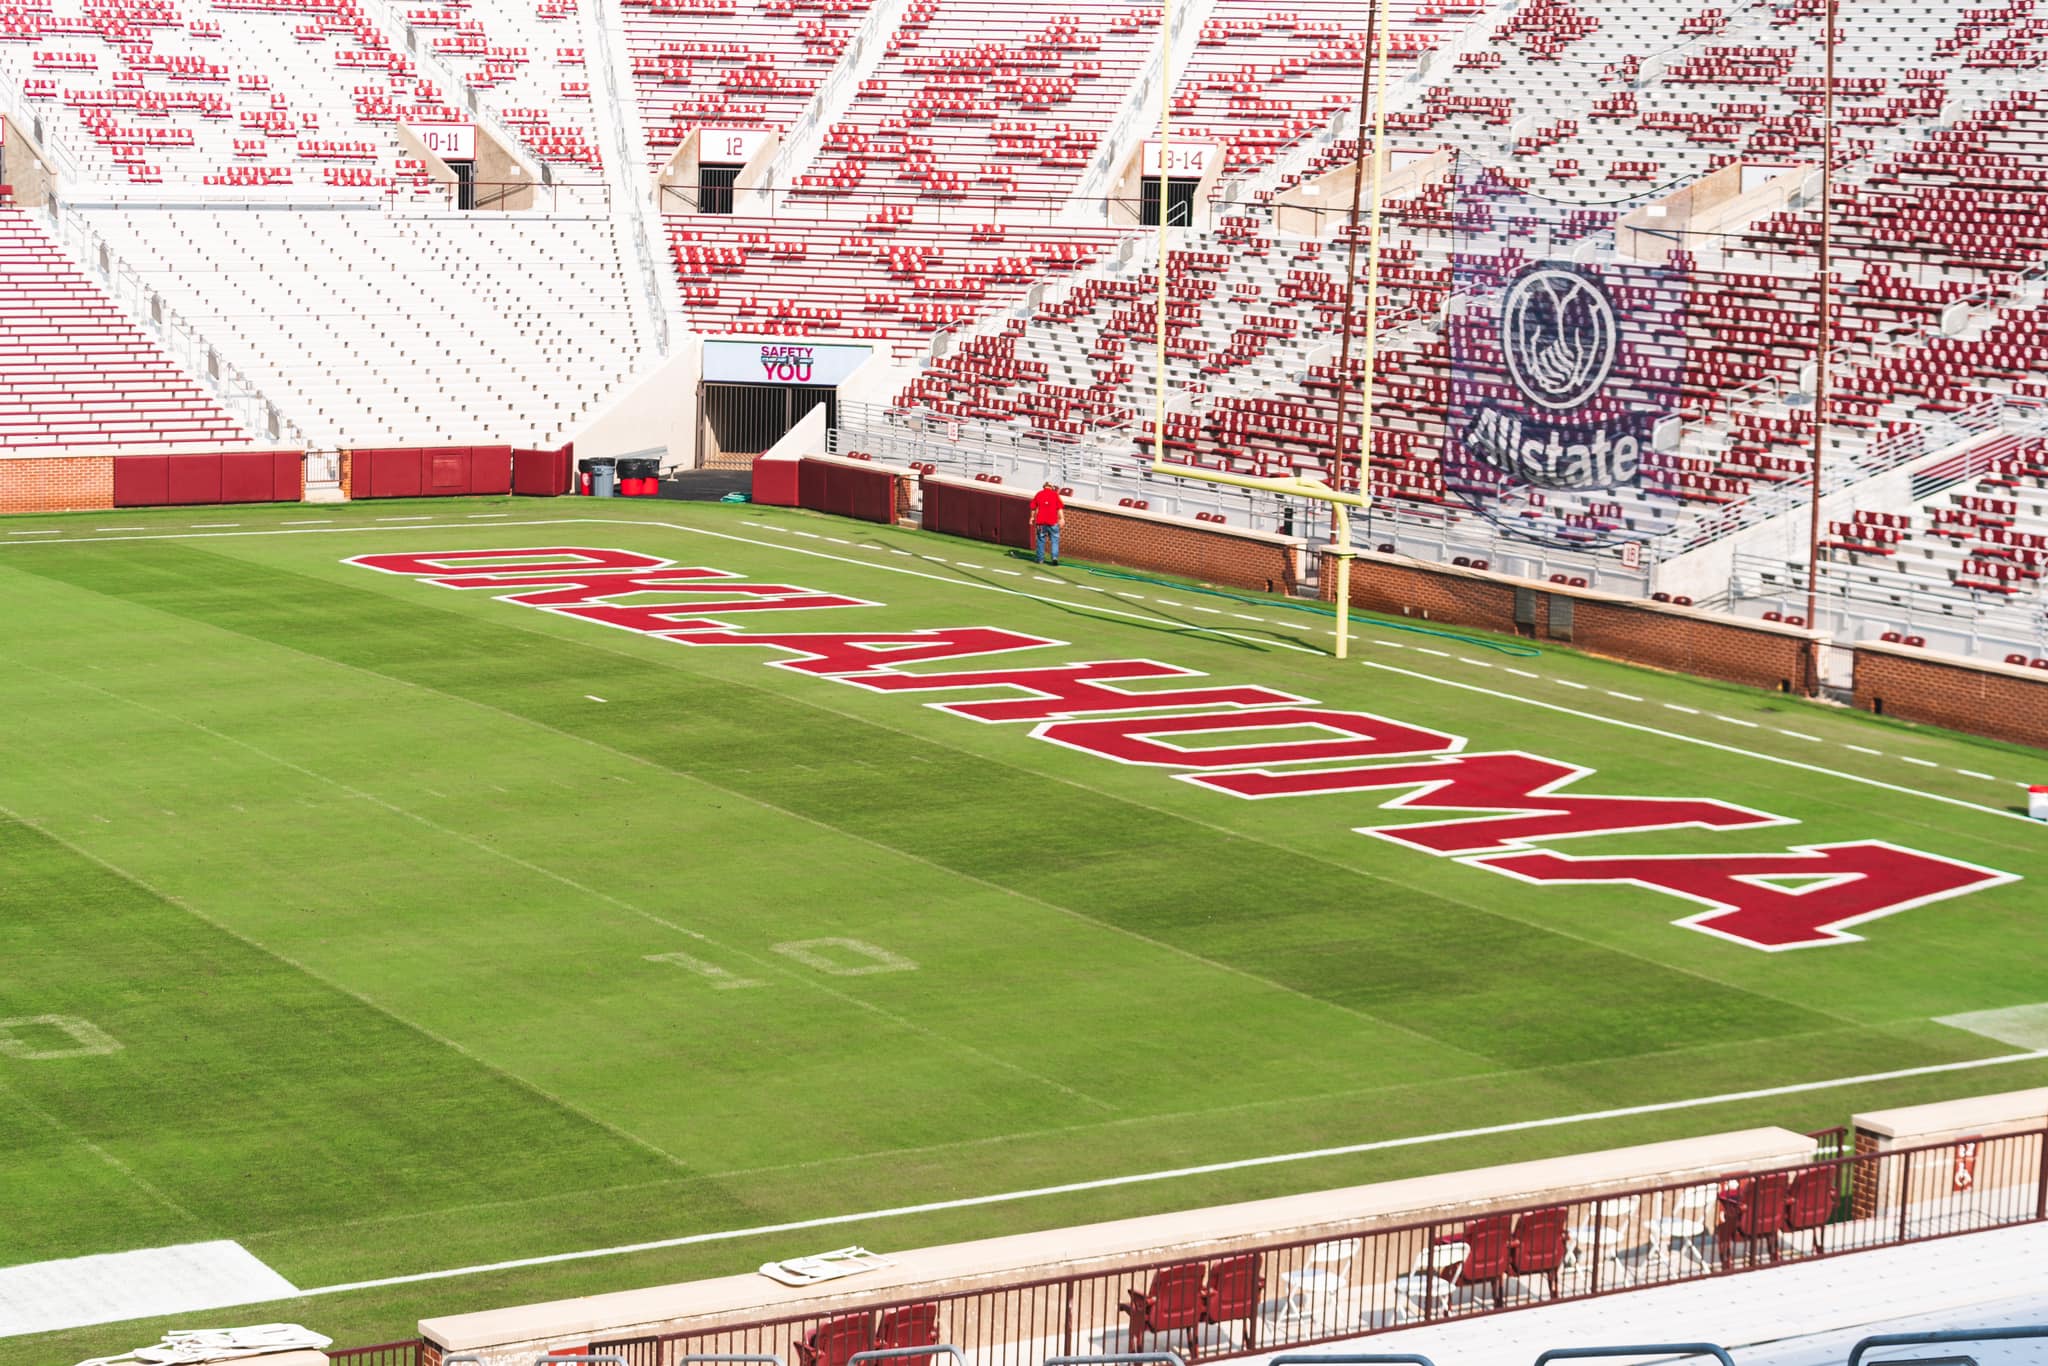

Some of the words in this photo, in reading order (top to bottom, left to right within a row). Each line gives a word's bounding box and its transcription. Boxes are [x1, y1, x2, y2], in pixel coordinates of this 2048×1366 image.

[422, 132, 459, 152] 10-11
[726, 137, 743, 156] 12
[1157, 150, 1203, 170] 13-14
[761, 346, 813, 358] SAFETY
[762, 362, 812, 382] YOU
[1466, 407, 1640, 489] Allstate
[338, 545, 2024, 952] OKLAHOMA
